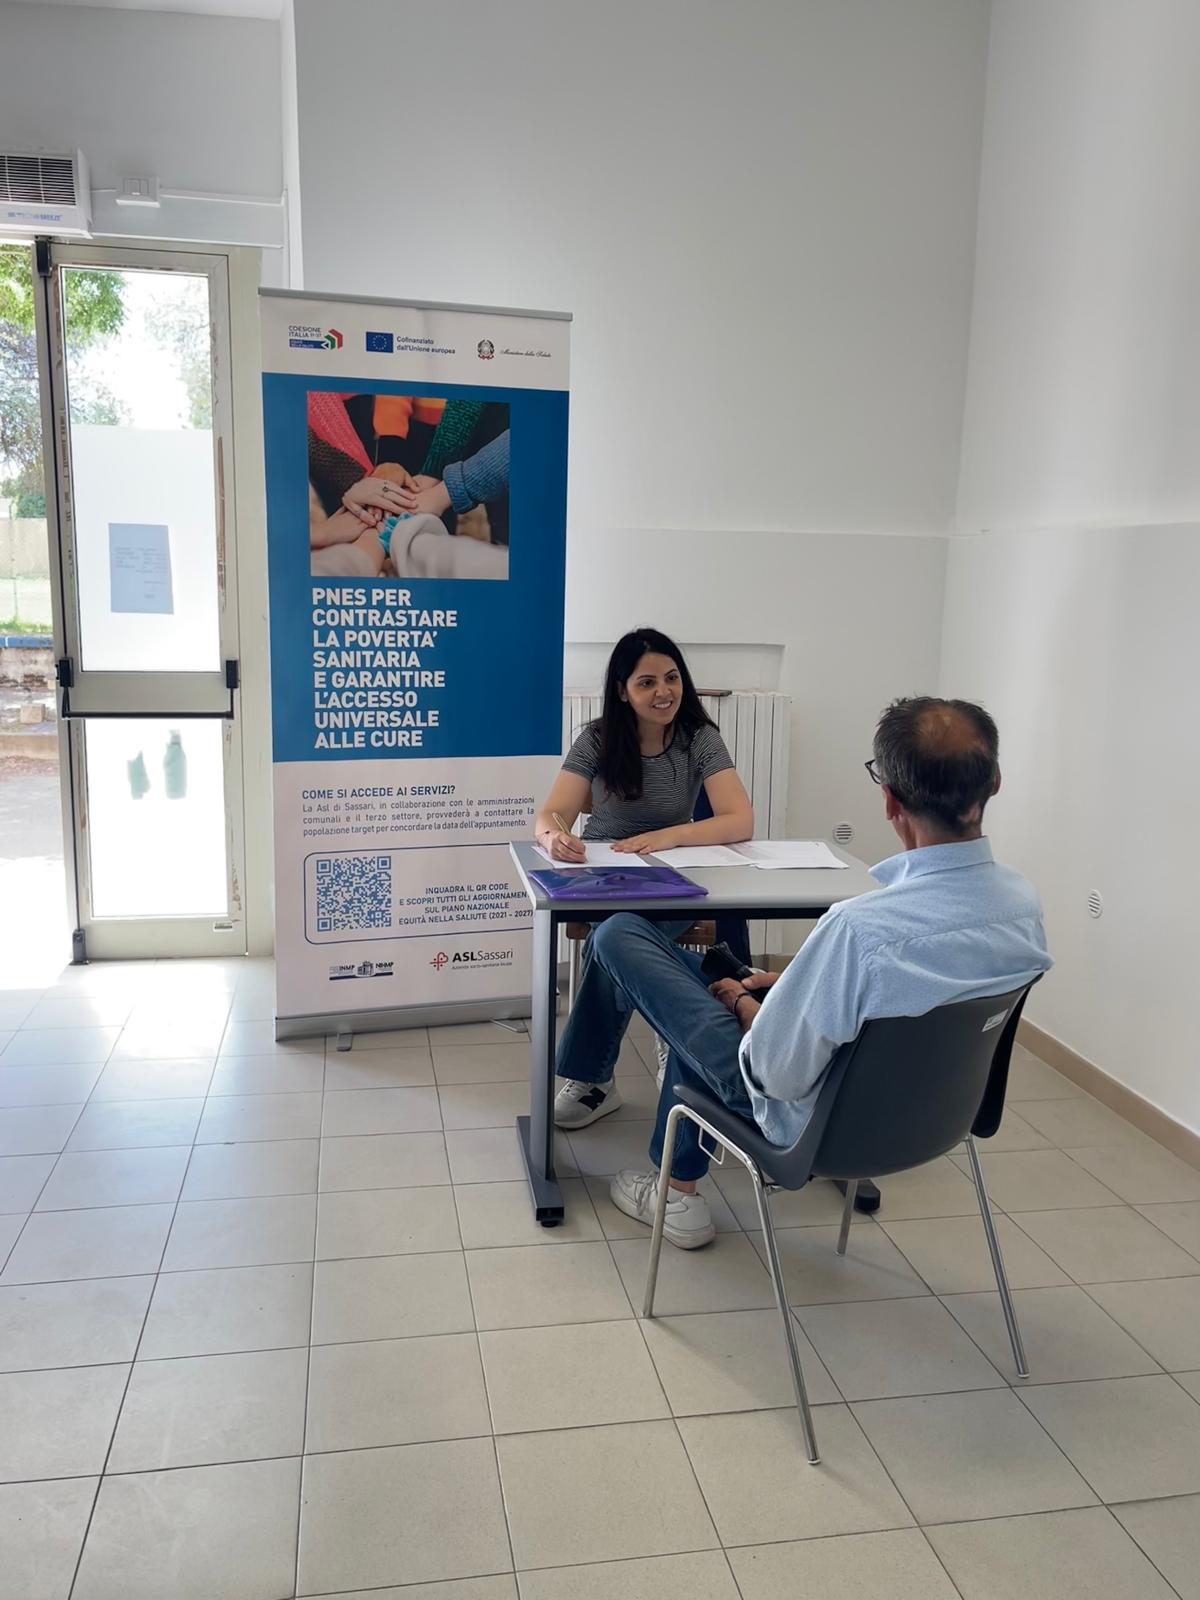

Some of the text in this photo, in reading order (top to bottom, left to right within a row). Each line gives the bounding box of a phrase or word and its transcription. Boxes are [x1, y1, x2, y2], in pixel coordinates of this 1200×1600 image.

[288, 325, 321, 333] COESIONE
[396, 336, 434, 345] Cofinanziato
[396, 345, 456, 355] dall'Unione europea
[312, 588, 412, 606] PNES PER
[312, 608, 458, 627] CONTRASTARE
[313, 629, 340, 648] LA
[313, 651, 421, 668] SANITARIA
[314, 670, 446, 688] E GARANTIRE
[314, 690, 418, 709] L’ACCESSO
[314, 710, 440, 729] UNIVERSALE
[314, 730, 423, 749] ALLE CURE
[302, 785, 456, 799] COME SI ACCEDE AI SERVIZI?
[302, 804, 313, 813] La
[316, 804, 330, 812] Asl
[333, 803, 341, 811] di
[344, 802, 376, 811] Sassari,
[379, 801, 387, 809] in
[390, 799, 446, 809] collaborazione
[466, 798, 474, 806] le
[477, 797, 535, 806] amministrazioni
[303, 815, 341, 824] comunali
[355, 814, 361, 822] il
[391, 811, 423, 821] settore,
[426, 809, 471, 820] provvederà
[474, 809, 480, 817] a
[483, 808, 524, 817] contattare
[527, 807, 535, 815] la
[303, 826, 350, 837] popolazione
[351, 825, 375, 835] target
[375, 825, 389, 834] per
[390, 822, 433, 832] concordare
[434, 821, 441, 830] la
[442, 821, 459, 830] data
[425, 886, 465, 894] INQUADRA
[489, 883, 509, 891] CODE
[406, 897, 435, 905] SCOPRI
[436, 895, 457, 904] TUTTI
[424, 902, 510, 914] SUL PIANO NAZIONALE
[398, 915, 427, 925] EQUITÀ
[428, 914, 454, 923] NELLA
[489, 911, 507, 919] (2021
[514, 909, 534, 917] 2027)
